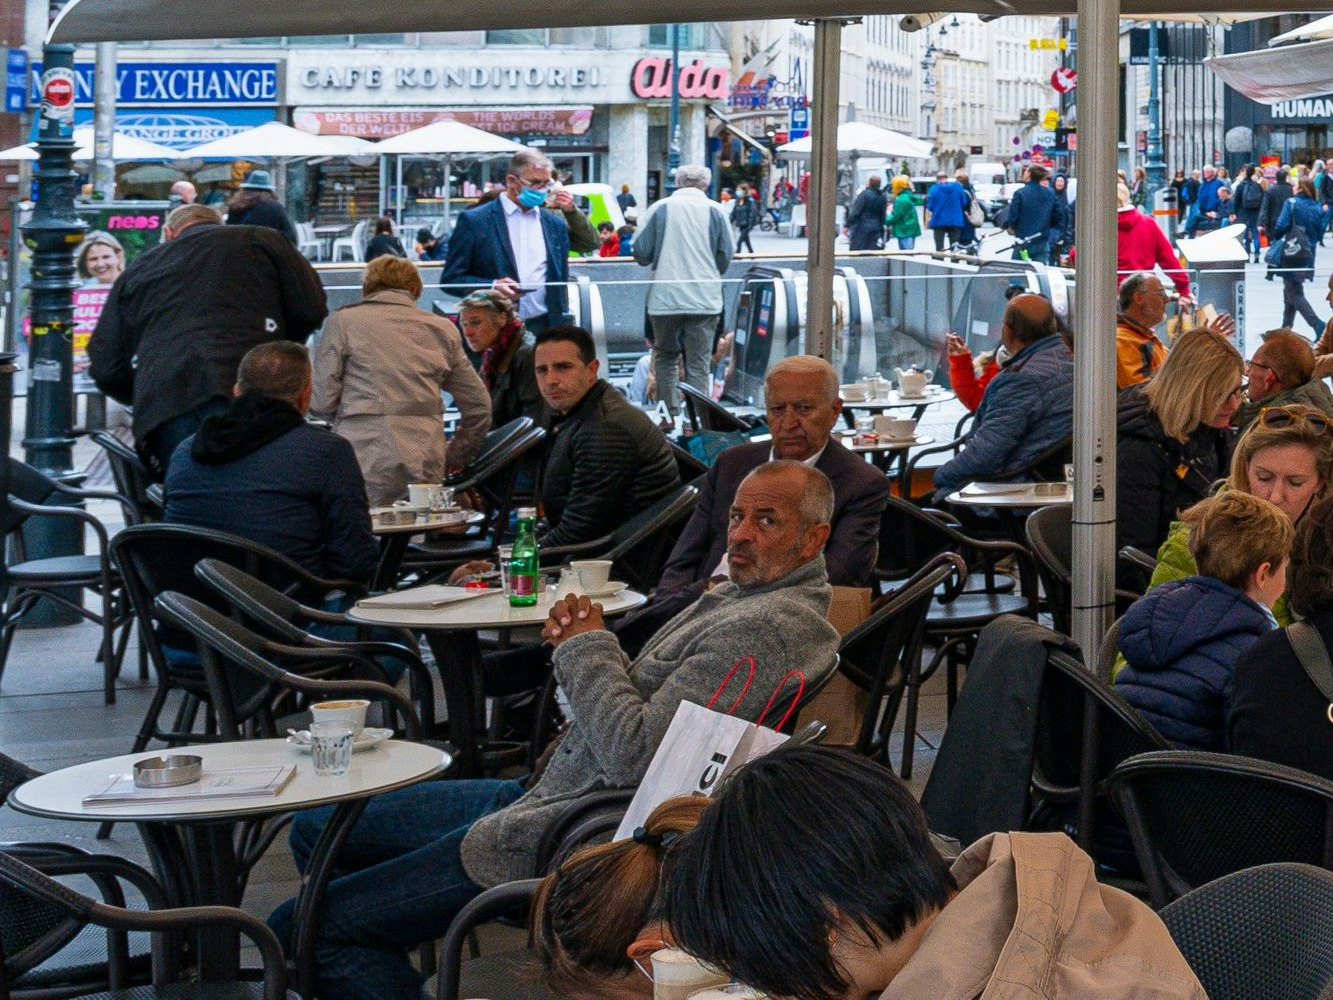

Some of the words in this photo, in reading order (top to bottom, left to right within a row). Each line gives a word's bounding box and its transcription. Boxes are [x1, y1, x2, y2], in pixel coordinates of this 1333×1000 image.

[396, 66, 600, 88] KONDITOREI
[135, 70, 276, 99] EXCHANGE
[325, 112, 352, 122] DAS
[355, 112, 396, 122] BESTE
[400, 111, 424, 122] EIS
[473, 111, 497, 121] THE
[340, 123, 365, 134] DER
[497, 121, 519, 132] ICE
[522, 120, 566, 131] CREAM
[108, 215, 160, 230] neos
